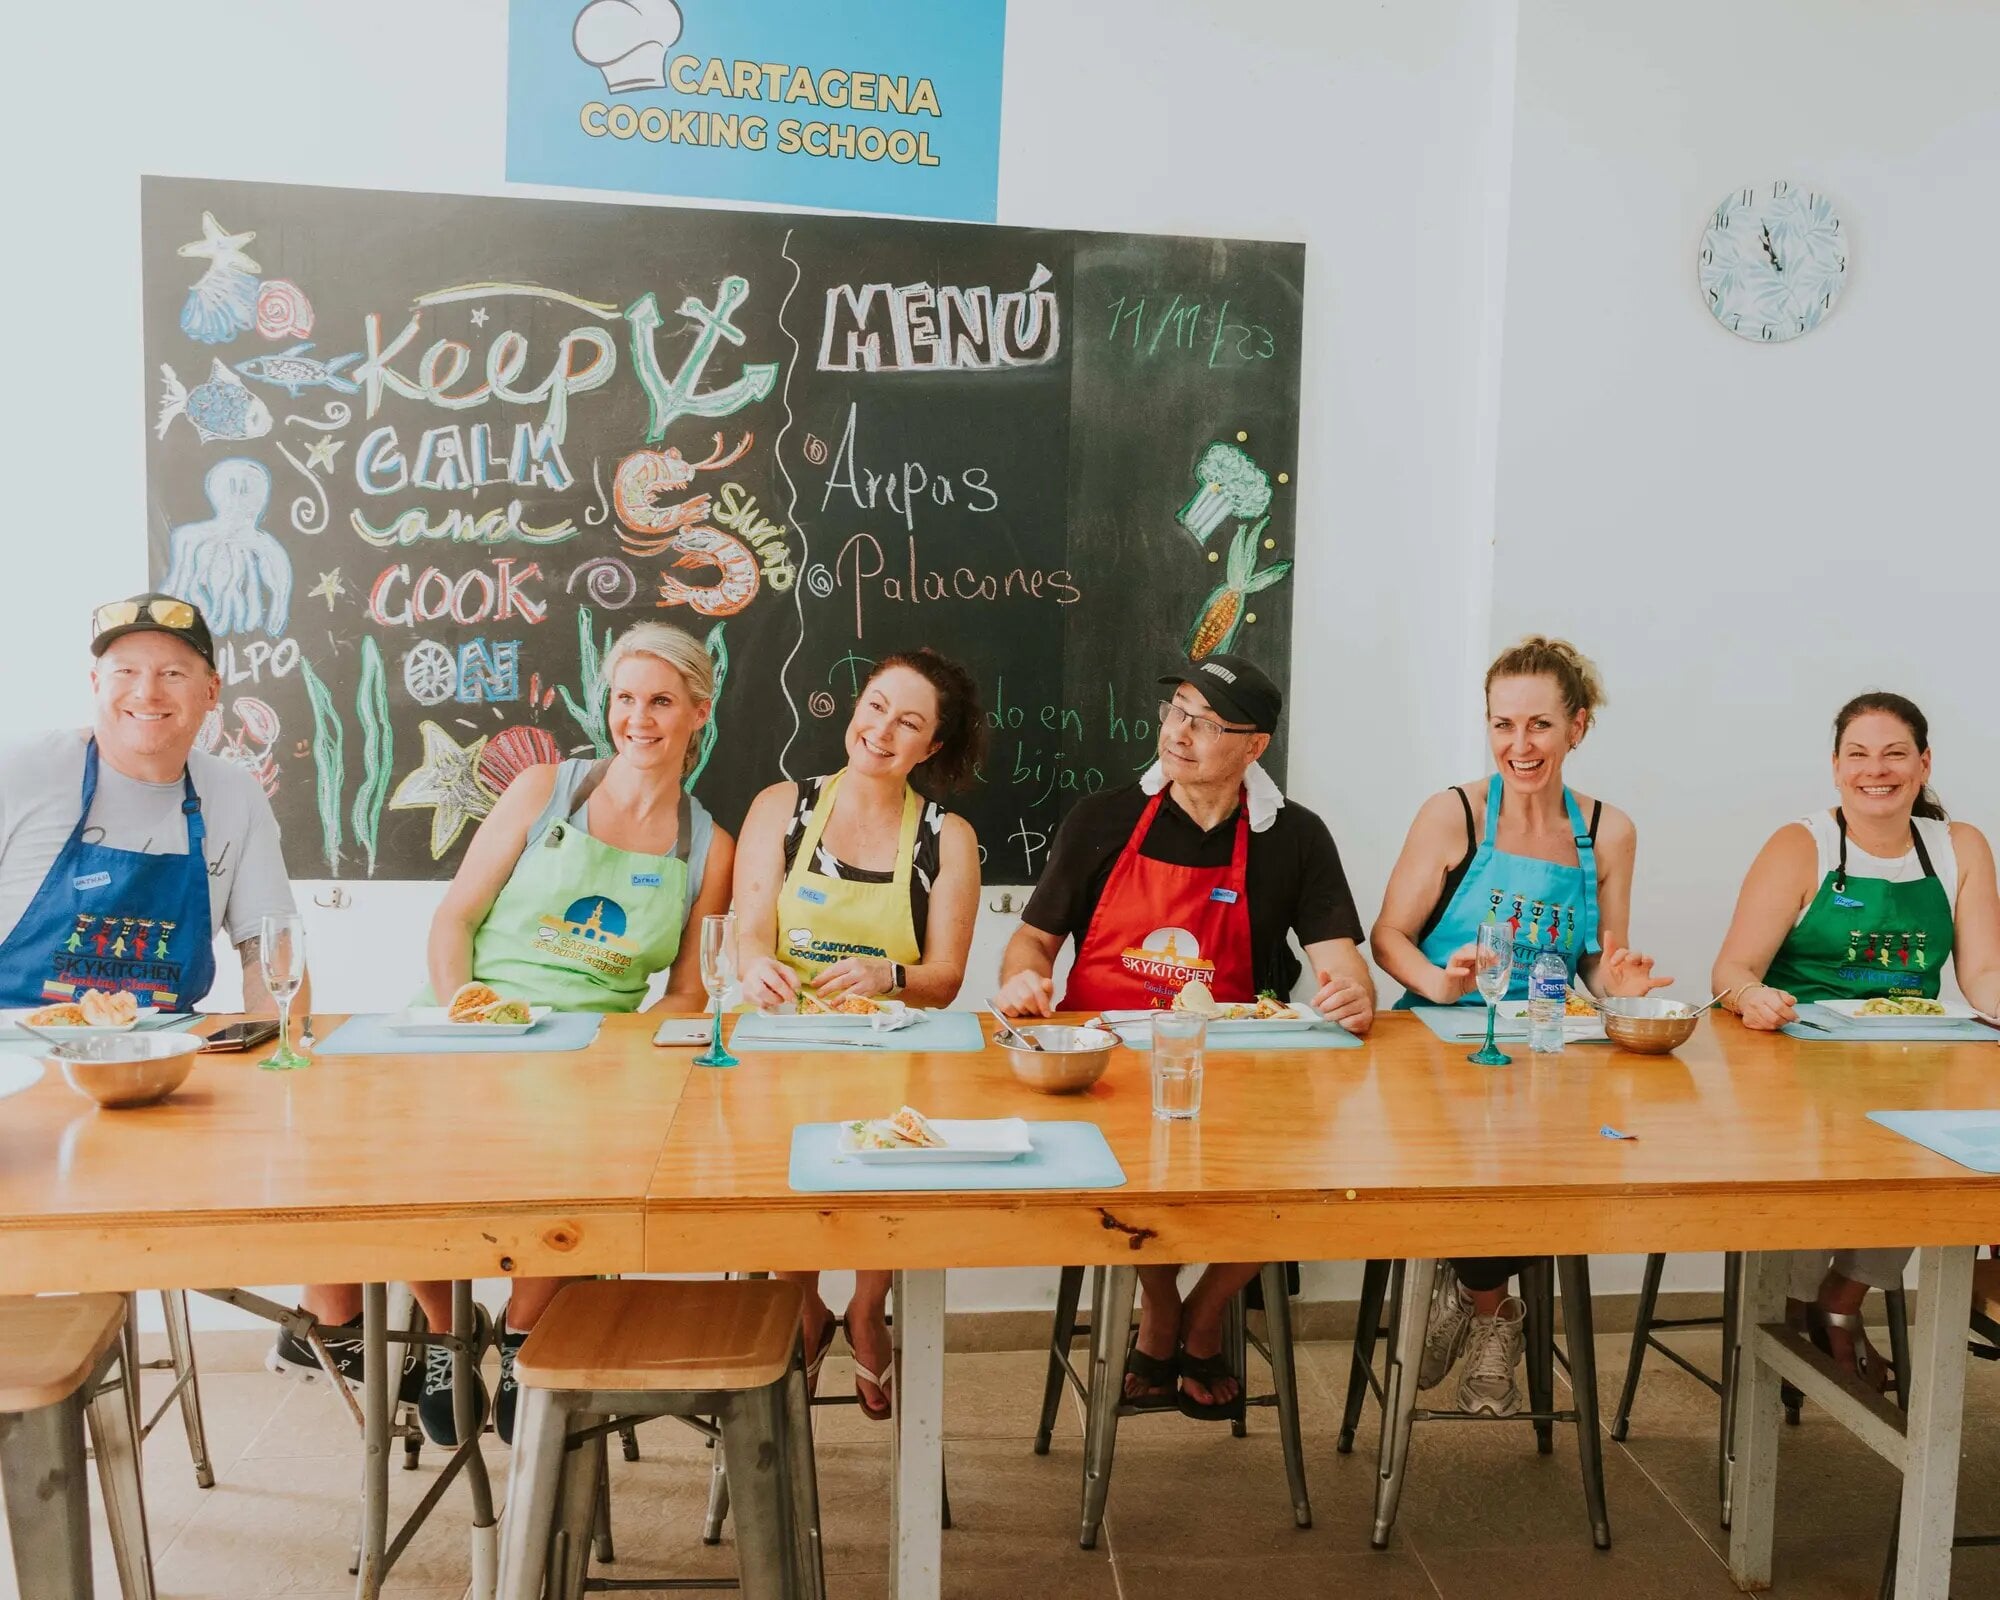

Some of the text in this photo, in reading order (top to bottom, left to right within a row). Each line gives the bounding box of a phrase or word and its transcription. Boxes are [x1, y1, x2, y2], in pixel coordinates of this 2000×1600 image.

[669, 54, 942, 117] CARTAGENA
[580, 101, 940, 166] COOKING SCHOOL
[1742, 189, 1753, 207] 11
[1773, 181, 1788, 199] 12
[1809, 192, 1814, 210] 1
[1715, 213, 1729, 231] 10
[1830, 219, 1840, 237] 2
[1703, 249, 1713, 266] 9
[1837, 256, 1845, 273] 3
[1709, 287, 1719, 303] 8
[1820, 292, 1830, 309] 4
[817, 262, 1059, 371] MENÚ
[1733, 313, 1742, 331] 7
[1795, 316, 1806, 333] 5
[1762, 324, 1776, 340] 6
[352, 311, 617, 445] Keep
[821, 402, 998, 530] Arepas
[358, 501, 570, 546] and
[369, 558, 547, 627] COOK
[405, 637, 522, 705] ON
[1200, 663, 1237, 684] PUMA
[1041, 705, 1082, 742] en
[802, 889, 819, 901] MEL
[54, 956, 181, 982] SKYKITCHEN
[1121, 956, 1214, 983] SKYKITCHEN
